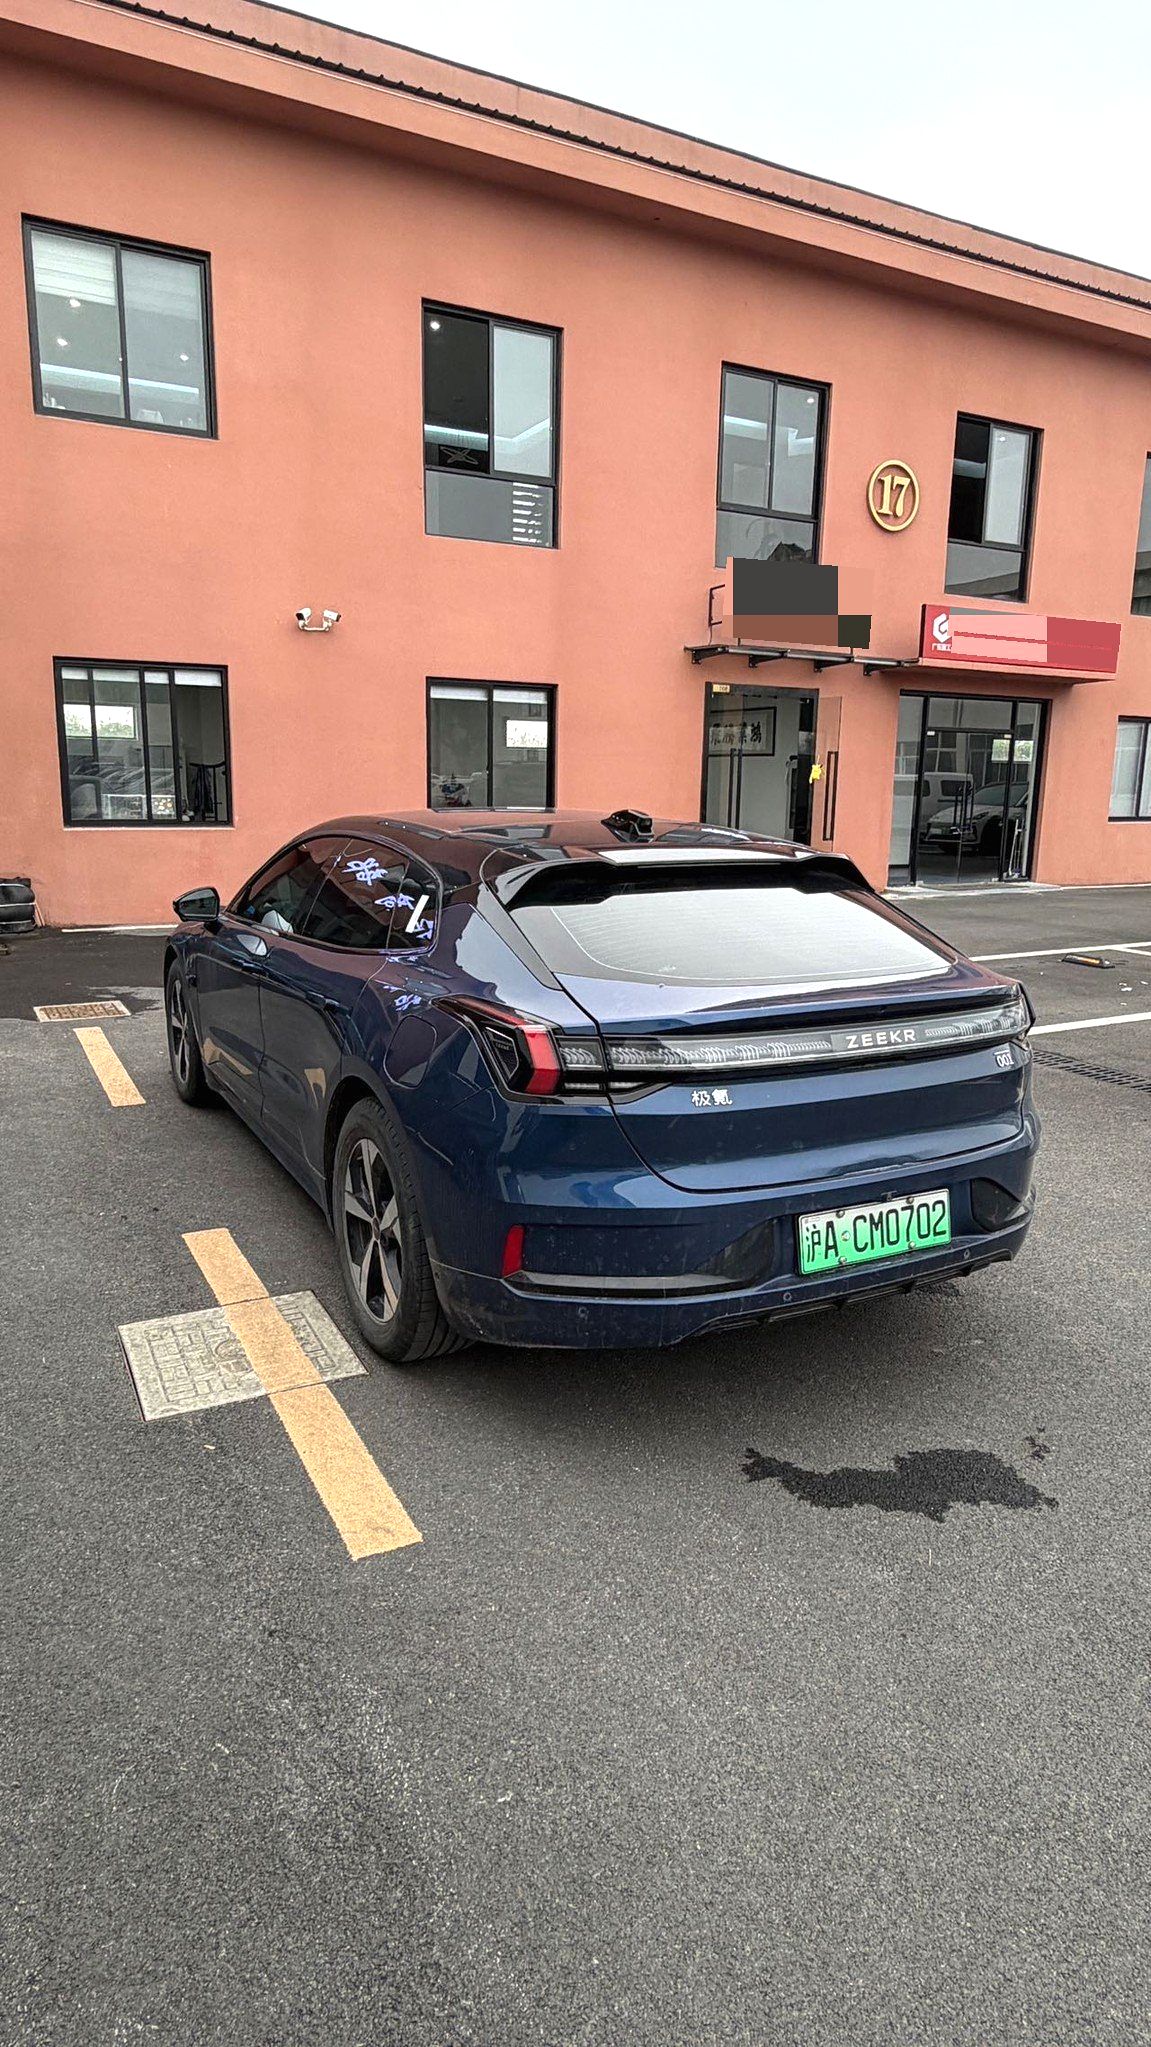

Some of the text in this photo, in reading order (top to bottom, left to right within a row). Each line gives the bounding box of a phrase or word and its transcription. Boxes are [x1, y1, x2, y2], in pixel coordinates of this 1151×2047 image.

[878, 474, 911, 517] 17
[846, 1028, 916, 1049] ZEEKR
[692, 1088, 733, 1107] 极氪
